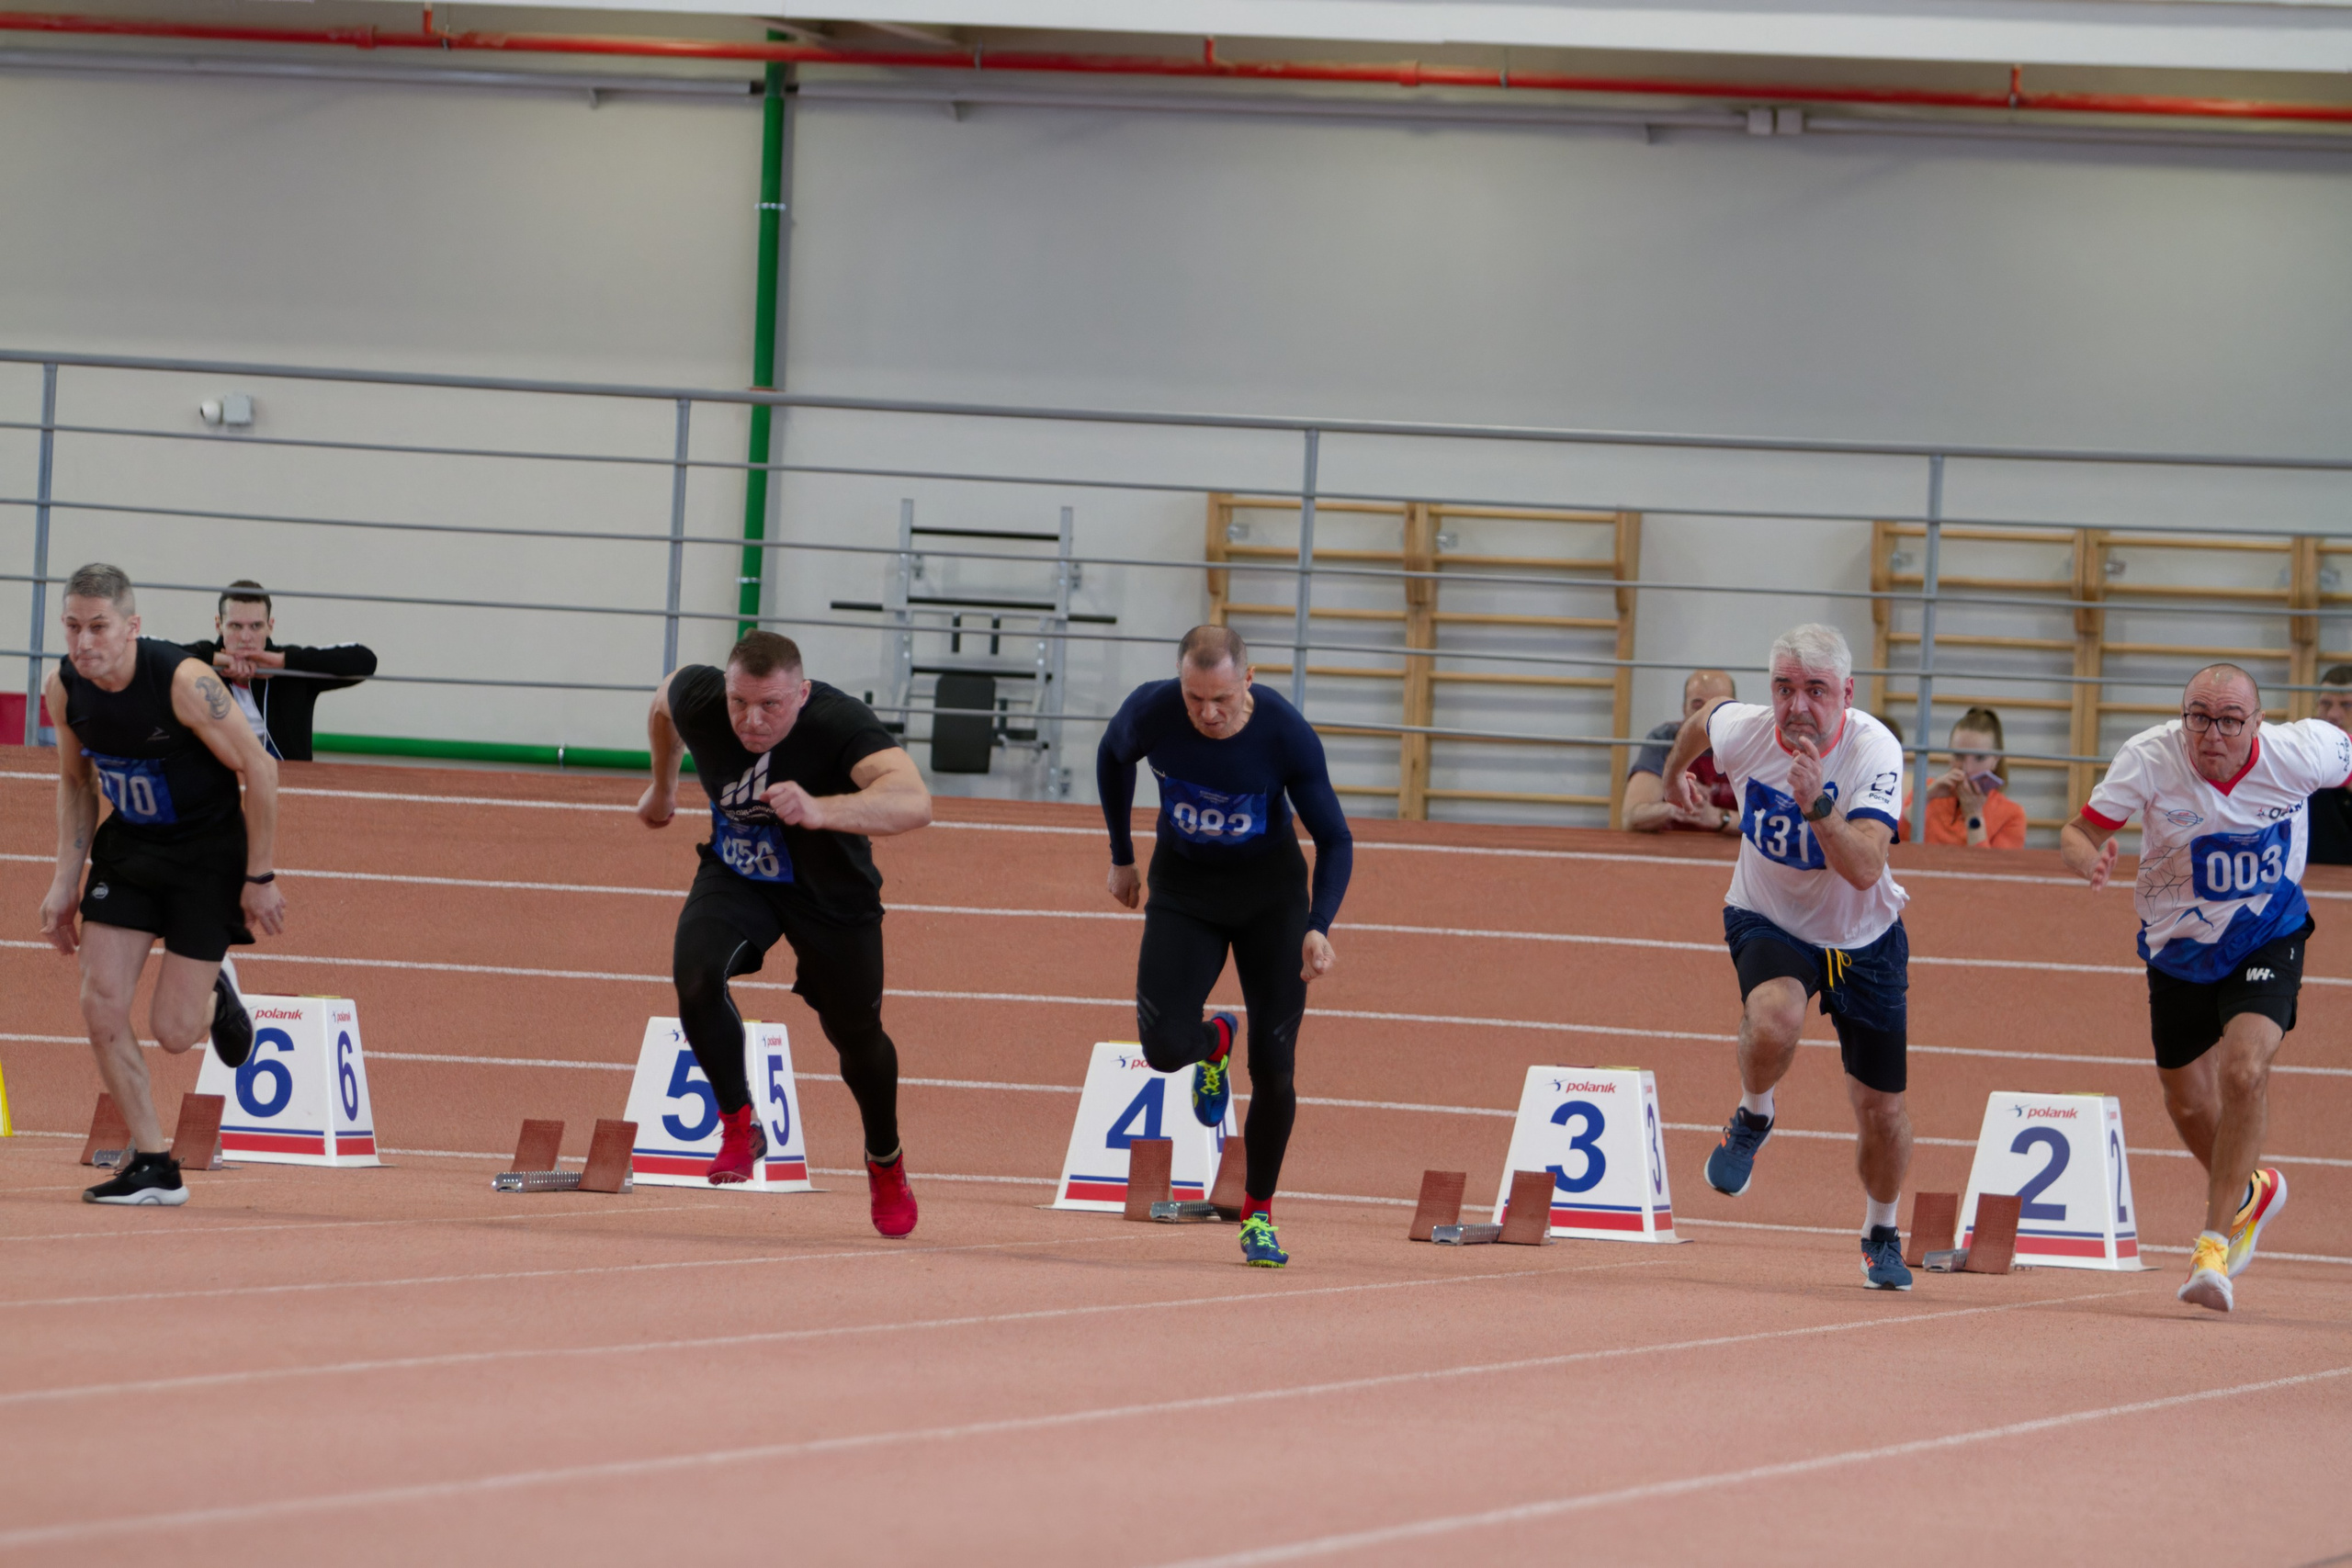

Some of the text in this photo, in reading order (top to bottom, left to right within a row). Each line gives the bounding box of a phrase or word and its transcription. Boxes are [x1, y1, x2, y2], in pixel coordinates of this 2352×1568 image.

[722, 835, 780, 877] 056
[1754, 807, 1810, 863] 131
[2206, 844, 2283, 893] 003
[254, 1008, 303, 1021] polanik
[235, 1027, 295, 1118] 6
[337, 1031, 358, 1122] 6
[662, 1050, 720, 1142] 5
[767, 1055, 790, 1146] 5
[1105, 1077, 1171, 1149] 4
[1566, 1081, 1616, 1094] polanik
[2027, 1106, 2078, 1119] polanik
[1545, 1100, 1606, 1193] 3
[1647, 1103, 1662, 1196] 3
[2009, 1126, 2071, 1222] 2
[2110, 1129, 2128, 1224] 2
